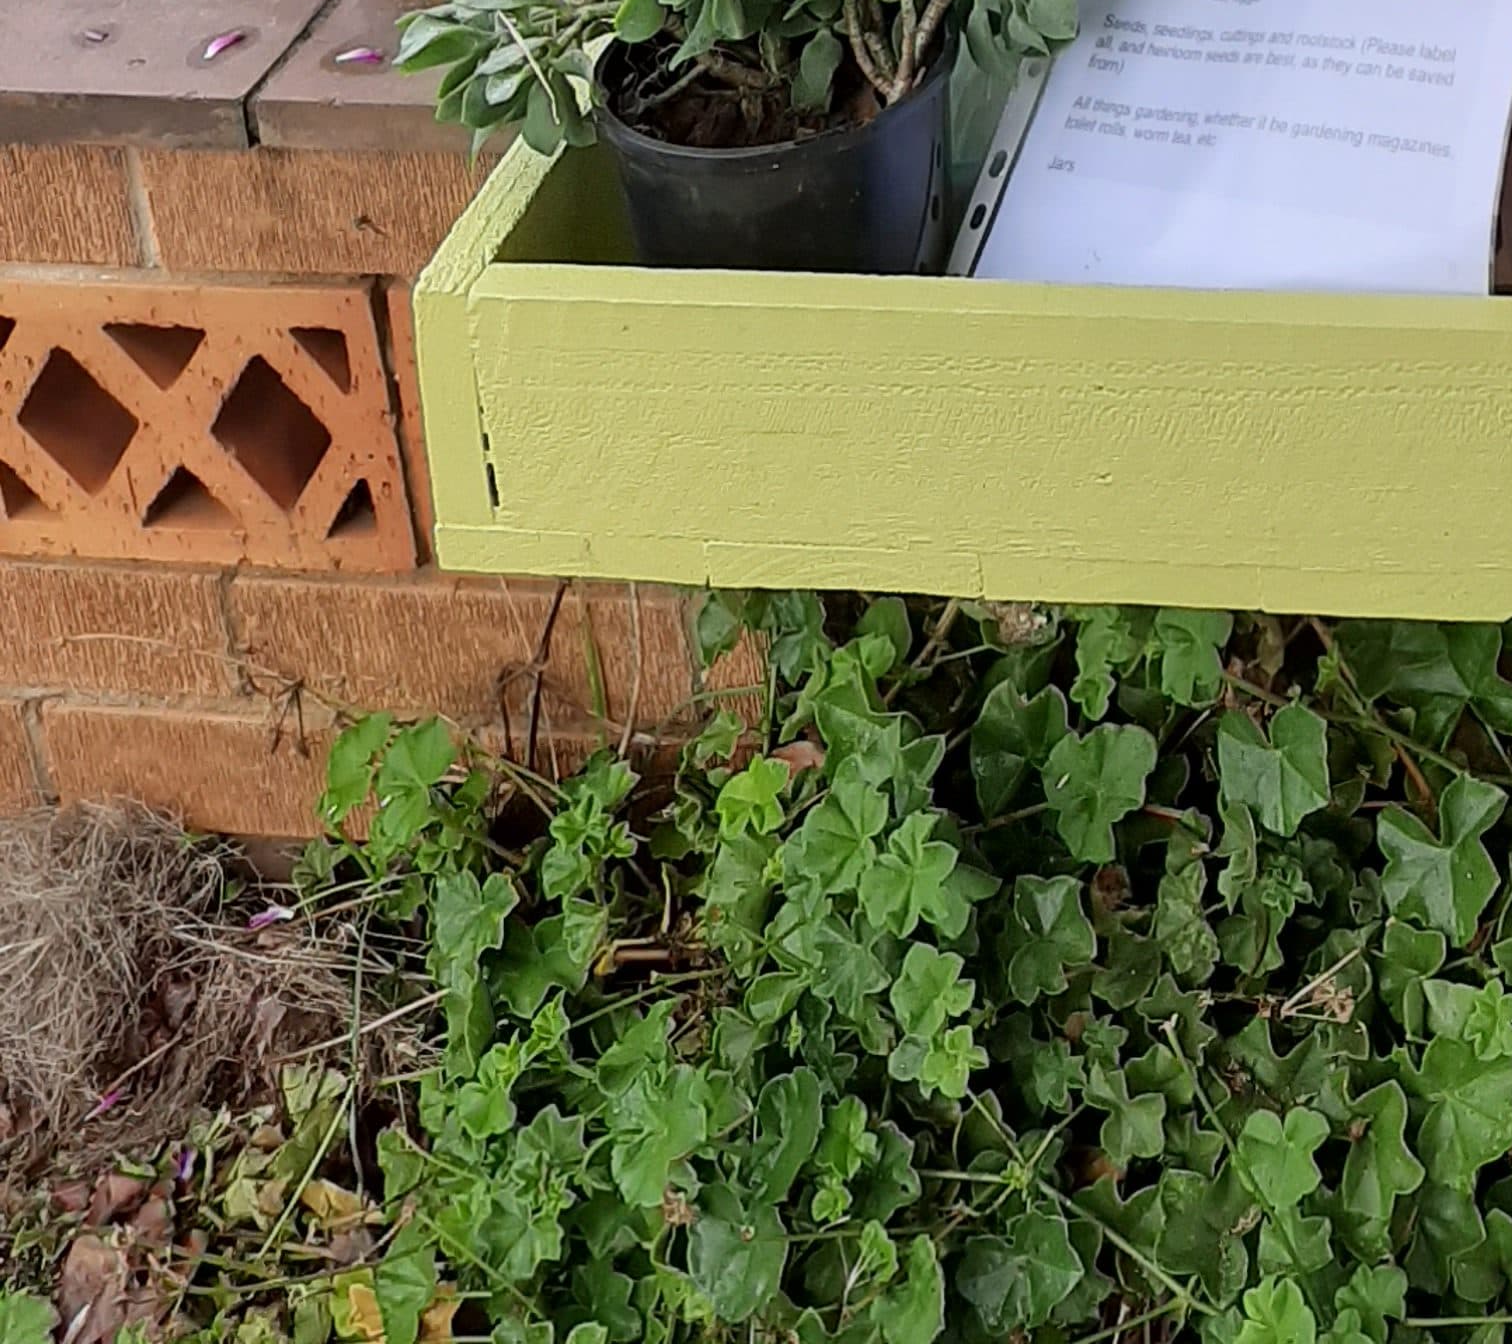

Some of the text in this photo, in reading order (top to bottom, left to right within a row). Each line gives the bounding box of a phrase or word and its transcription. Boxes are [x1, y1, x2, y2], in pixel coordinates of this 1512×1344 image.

[1267, 31, 1295, 45] and
[1295, 32, 1356, 50] rootstock
[1359, 35, 1417, 57] (Please
[1419, 42, 1457, 63] label
[1087, 52, 1127, 76] from)
[1118, 40, 1146, 55] and
[1147, 43, 1203, 61] heirloom
[1205, 49, 1241, 64] seeds
[1242, 52, 1264, 65] are
[1301, 55, 1319, 69] as
[1321, 55, 1354, 77] they
[1355, 62, 1383, 76] can
[1385, 63, 1406, 79] be
[1407, 67, 1456, 87] saved
[1063, 115, 1098, 133] toilet
[1132, 129, 1172, 143] worm
[1071, 95, 1093, 110] All
[1092, 97, 1131, 119] things
[1203, 111, 1256, 130] whether
[1257, 115, 1268, 131] it
[1269, 116, 1289, 134] be
[1291, 121, 1365, 148] gardening
[1047, 154, 1077, 173] Jars
